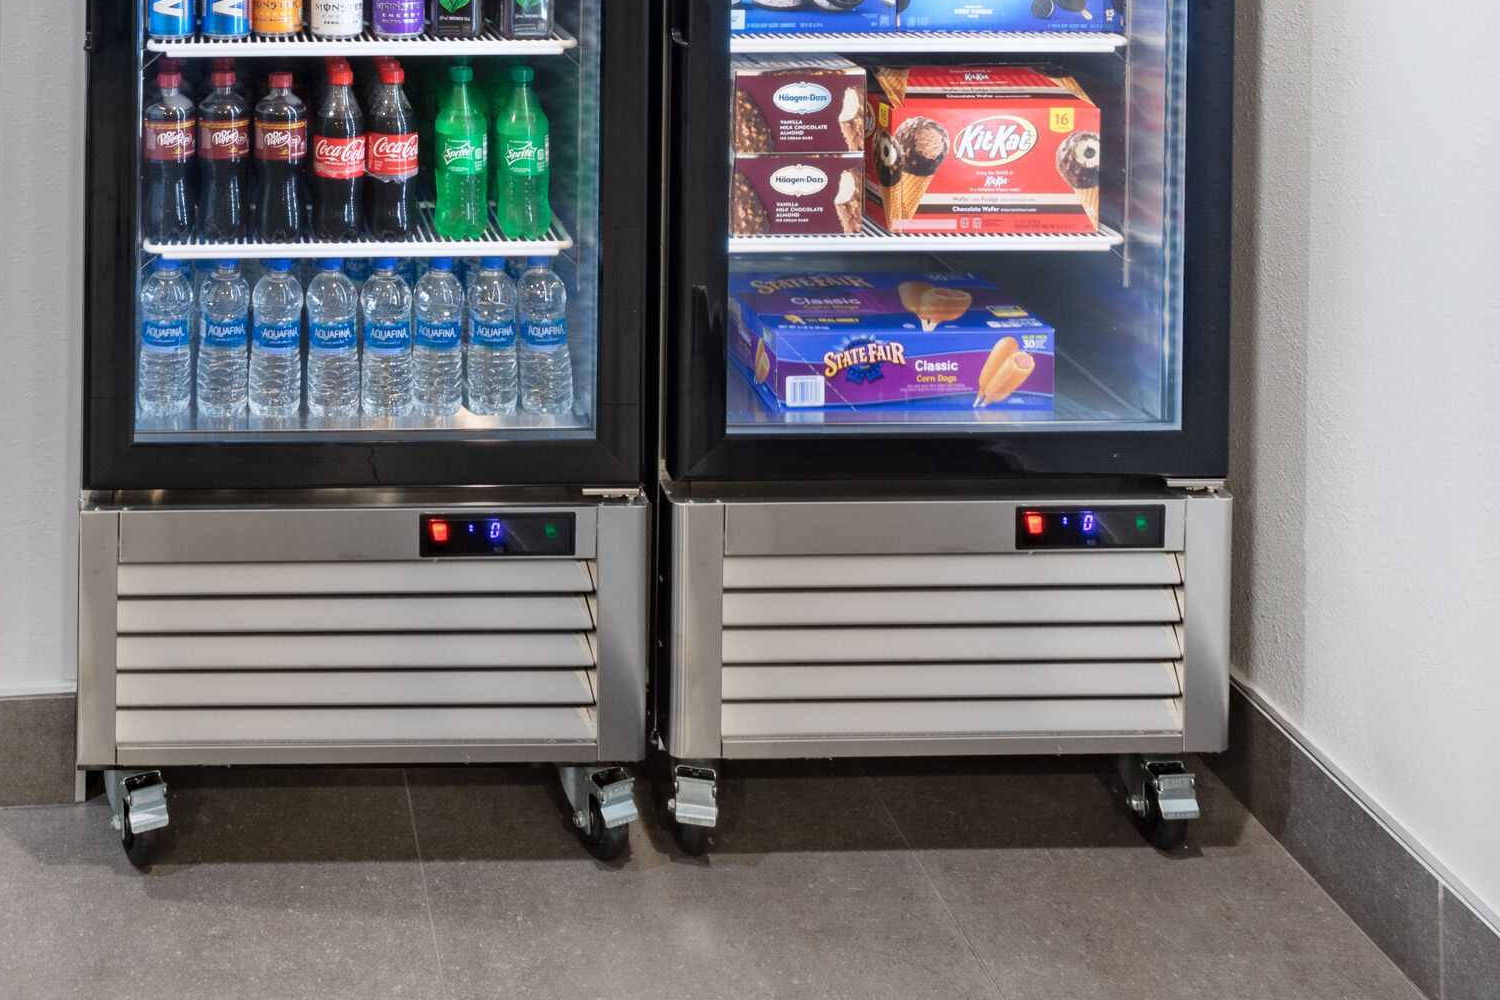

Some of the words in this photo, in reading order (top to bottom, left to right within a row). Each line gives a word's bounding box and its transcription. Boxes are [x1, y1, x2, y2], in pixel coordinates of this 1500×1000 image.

[1105, 8, 1115, 17] 15
[1054, 113, 1069, 126] 16
[445, 147, 474, 160] Sprite
[506, 147, 535, 160] Sprite
[981, 196, 998, 204] Fudge
[790, 297, 861, 305] Classic
[146, 325, 185, 340] AQUAFINA
[207, 324, 246, 338] AQUAFINA
[262, 327, 299, 341] AQUAFINA
[314, 327, 352, 342] AQUAFINA
[370, 325, 409, 340] AQUAFINA
[418, 324, 457, 339] AQUAFINA
[476, 324, 514, 338] AQUAFINA
[528, 324, 566, 338] AQUAFINA
[1022, 340, 1034, 349] 30
[823, 346, 866, 378] STATE
[867, 341, 907, 367] FAIR
[915, 359, 959, 372] Classic
[916, 374, 936, 383] Corn
[937, 374, 957, 384] Dogs
